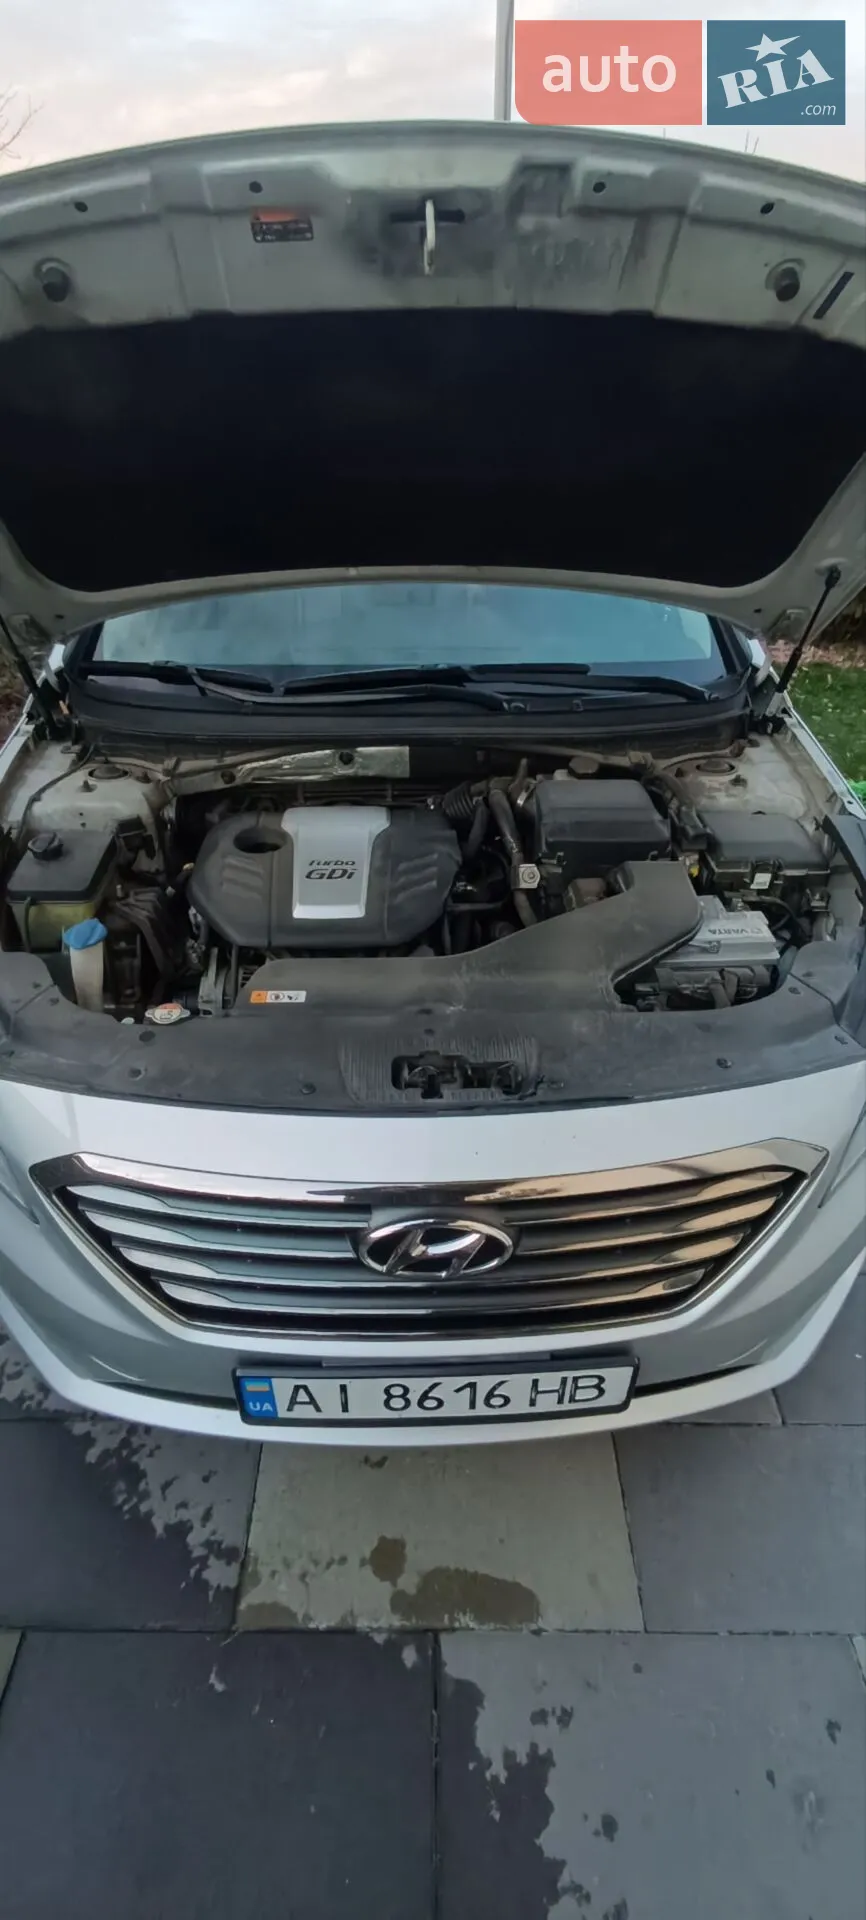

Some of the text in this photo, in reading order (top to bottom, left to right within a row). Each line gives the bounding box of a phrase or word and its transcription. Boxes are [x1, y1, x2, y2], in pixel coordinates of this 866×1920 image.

[286, 1374, 606, 1413] AI 8616 HB
[249, 1401, 273, 1412] UA
